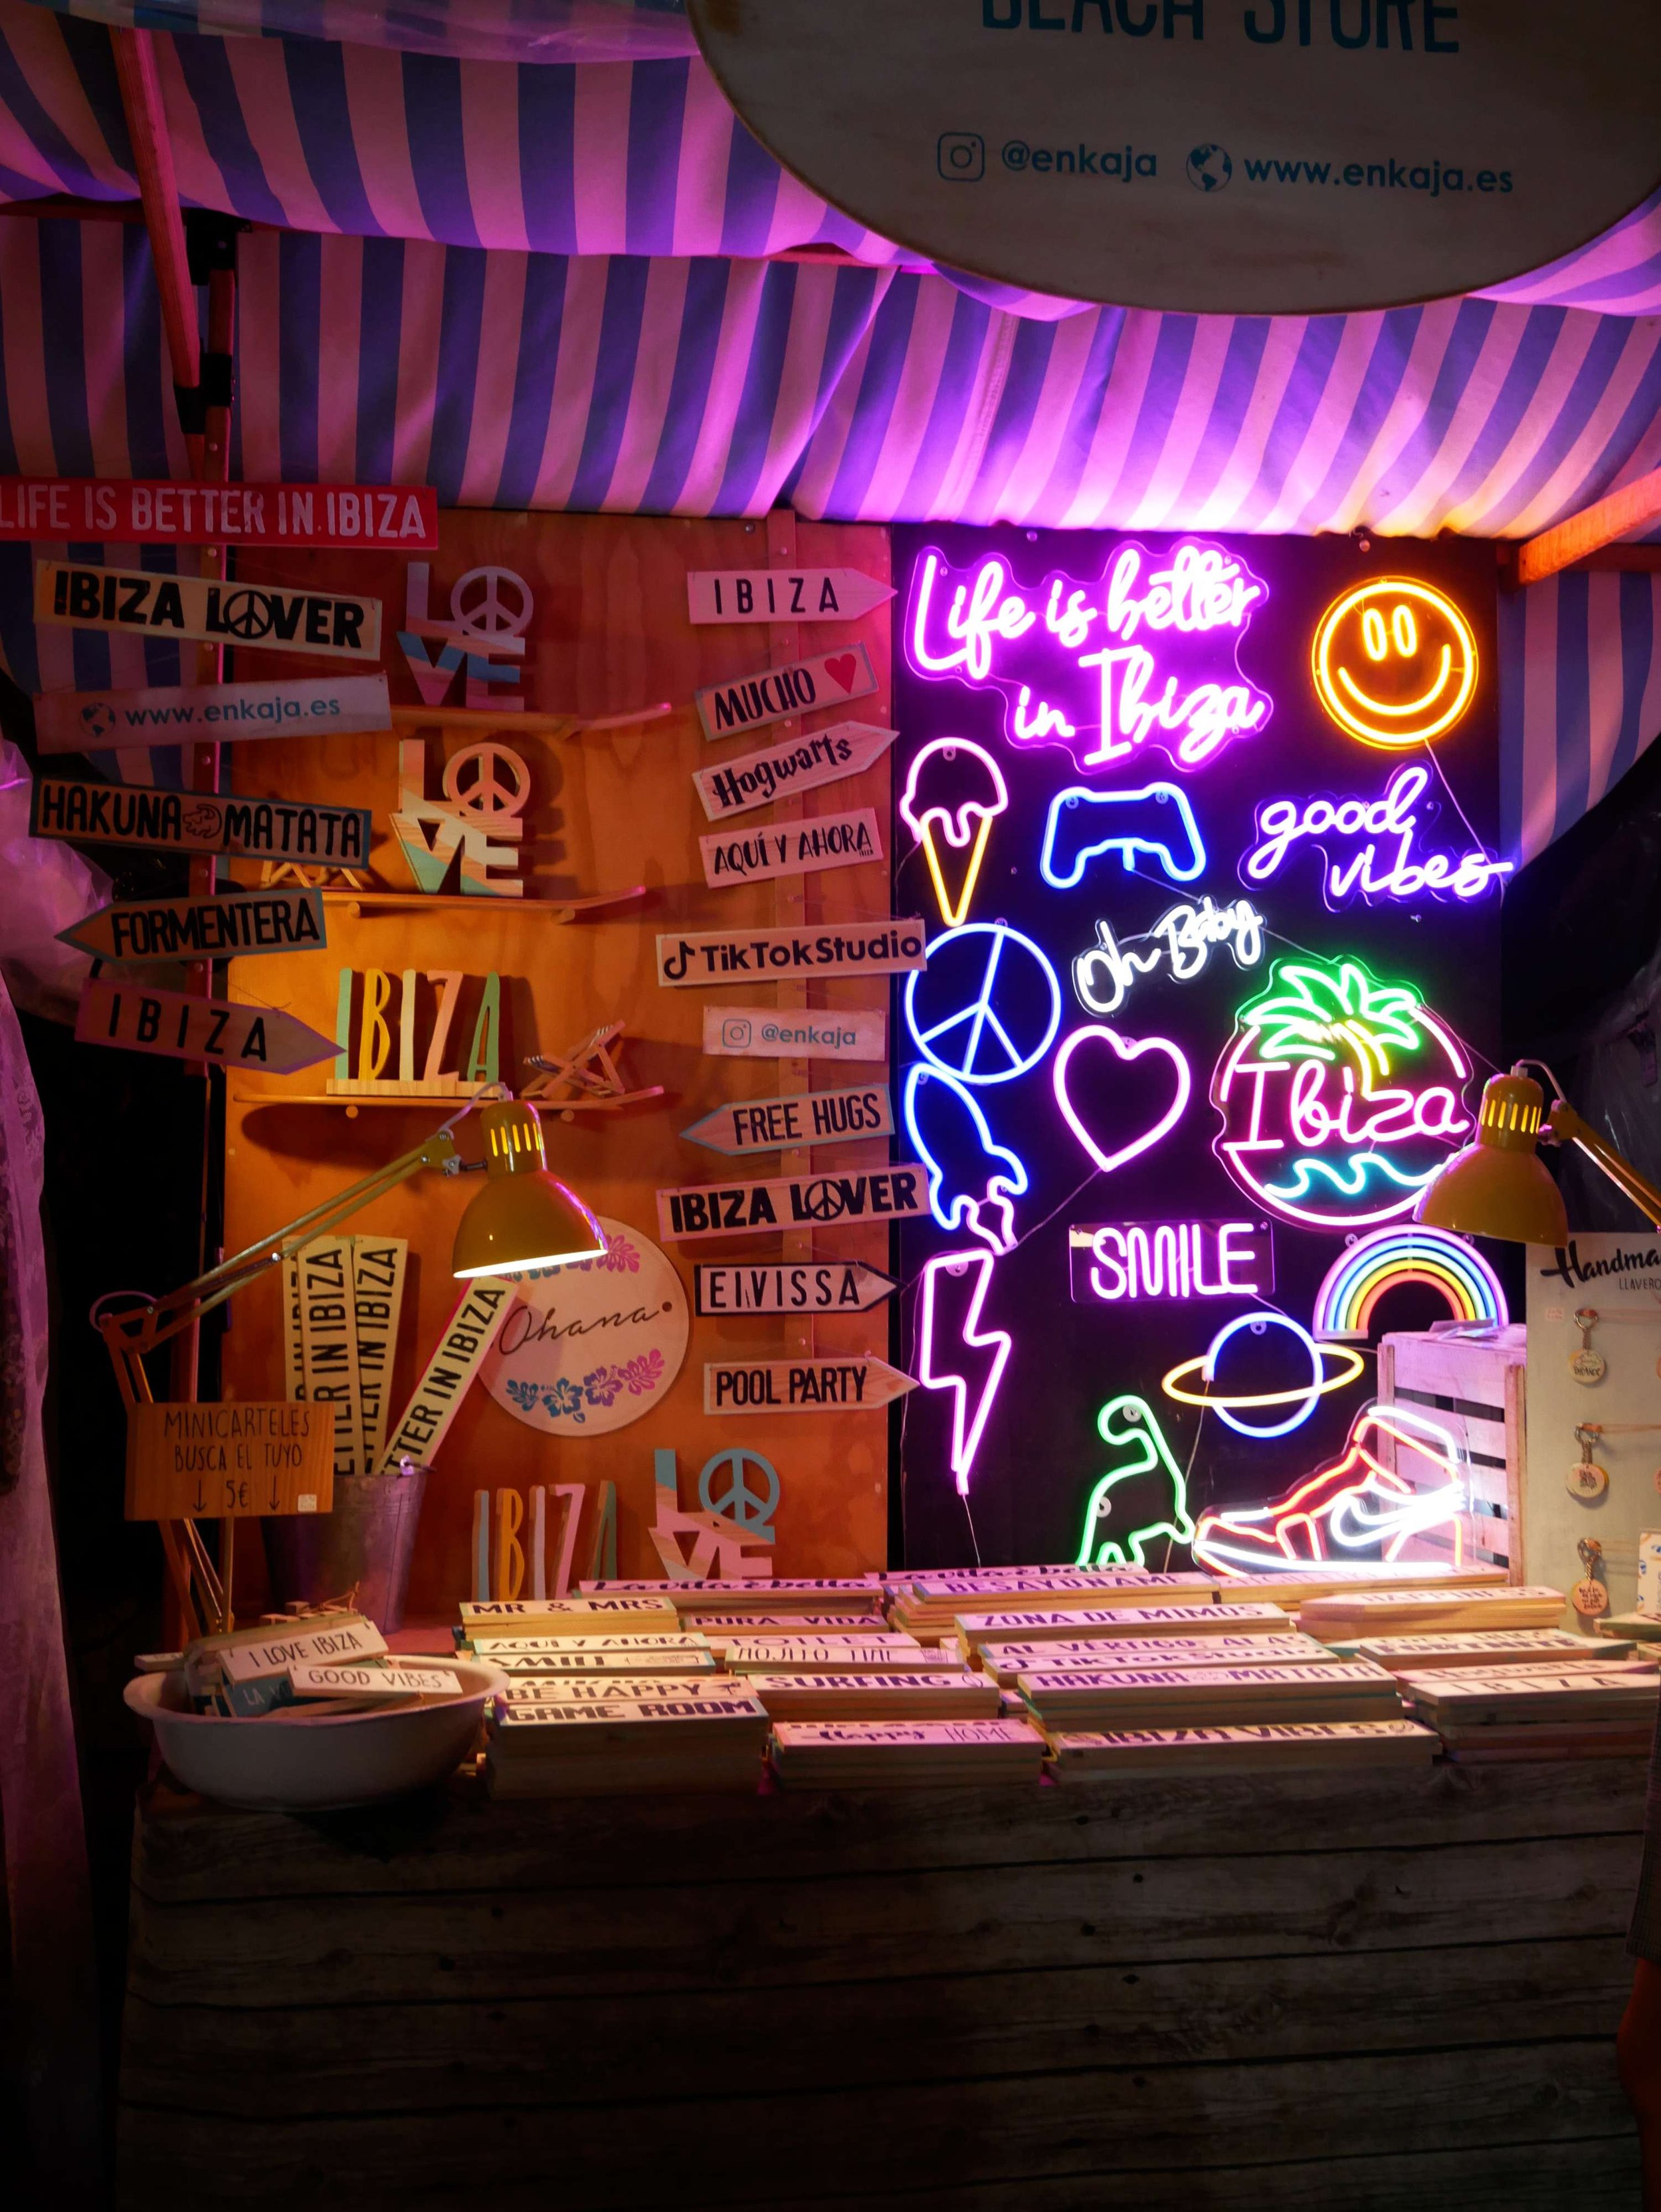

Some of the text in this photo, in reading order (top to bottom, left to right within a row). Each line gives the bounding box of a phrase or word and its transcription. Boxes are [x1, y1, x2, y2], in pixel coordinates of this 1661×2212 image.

[1001, 140, 1514, 197] @enkaja www.enkaja.es
[0, 484, 427, 538] LIFE IS BETTER IN IBIZA
[54, 570, 185, 629] IBIZA
[714, 577, 839, 614] IBIZA
[914, 546, 1260, 679] Life is better
[126, 695, 340, 728] www.enkaja.es
[714, 668, 816, 730] MUCHO
[1013, 645, 1264, 765] in Ibiza
[713, 735, 852, 808] Hogwarts
[43, 785, 361, 858] HAKUNA MATATA
[1248, 766, 1431, 879] good
[714, 821, 872, 876] AQUÍ Y AHORA
[1330, 830, 1513, 898] vibes
[111, 898, 320, 957] FORMENTERA
[1076, 921, 1159, 1013] Oh
[108, 994, 268, 1062] IBIZA
[335, 967, 500, 1082] IBIZA
[761, 1024, 856, 1049] @enkaja
[732, 1093, 881, 1146] FREE HUGS
[1223, 1059, 1469, 1150] Ibiza
[670, 1187, 777, 1233] IBIZA
[1091, 1223, 1258, 1299] SMILE
[306, 1248, 347, 1332] IBIZA
[355, 1248, 397, 1330] IBIZA
[710, 1270, 860, 1308] EIVISSA
[424, 1366, 462, 1401] IN
[451, 1286, 506, 1364] IBIZA
[498, 1304, 661, 1356] Ohana
[311, 1344, 349, 1373] IN
[357, 1340, 387, 1370] IN
[716, 1365, 867, 1406] POOL PARTY
[164, 1407, 310, 1439] MINICARTELES
[175, 1443, 302, 1472] BUSCA EL TUYO
[225, 1480, 249, 1509] 5€
[472, 1599, 663, 1614] MR & MRS
[977, 1605, 1263, 1627] ZONA DE MIMOS
[248, 1631, 362, 1668] I LOVE IBIZA
[602, 1636, 698, 1647] AHORA
[716, 1635, 888, 1647] TOILET
[739, 1647, 897, 1661] MOJITO TIME
[308, 1670, 442, 1688] GOOD VIBES
[506, 1684, 702, 1701] BE HAPPY
[765, 1675, 951, 1689] SURFING
[1037, 1665, 1385, 1687] HAKUNA MATATA
[506, 1700, 756, 1722] GAME ROOM
